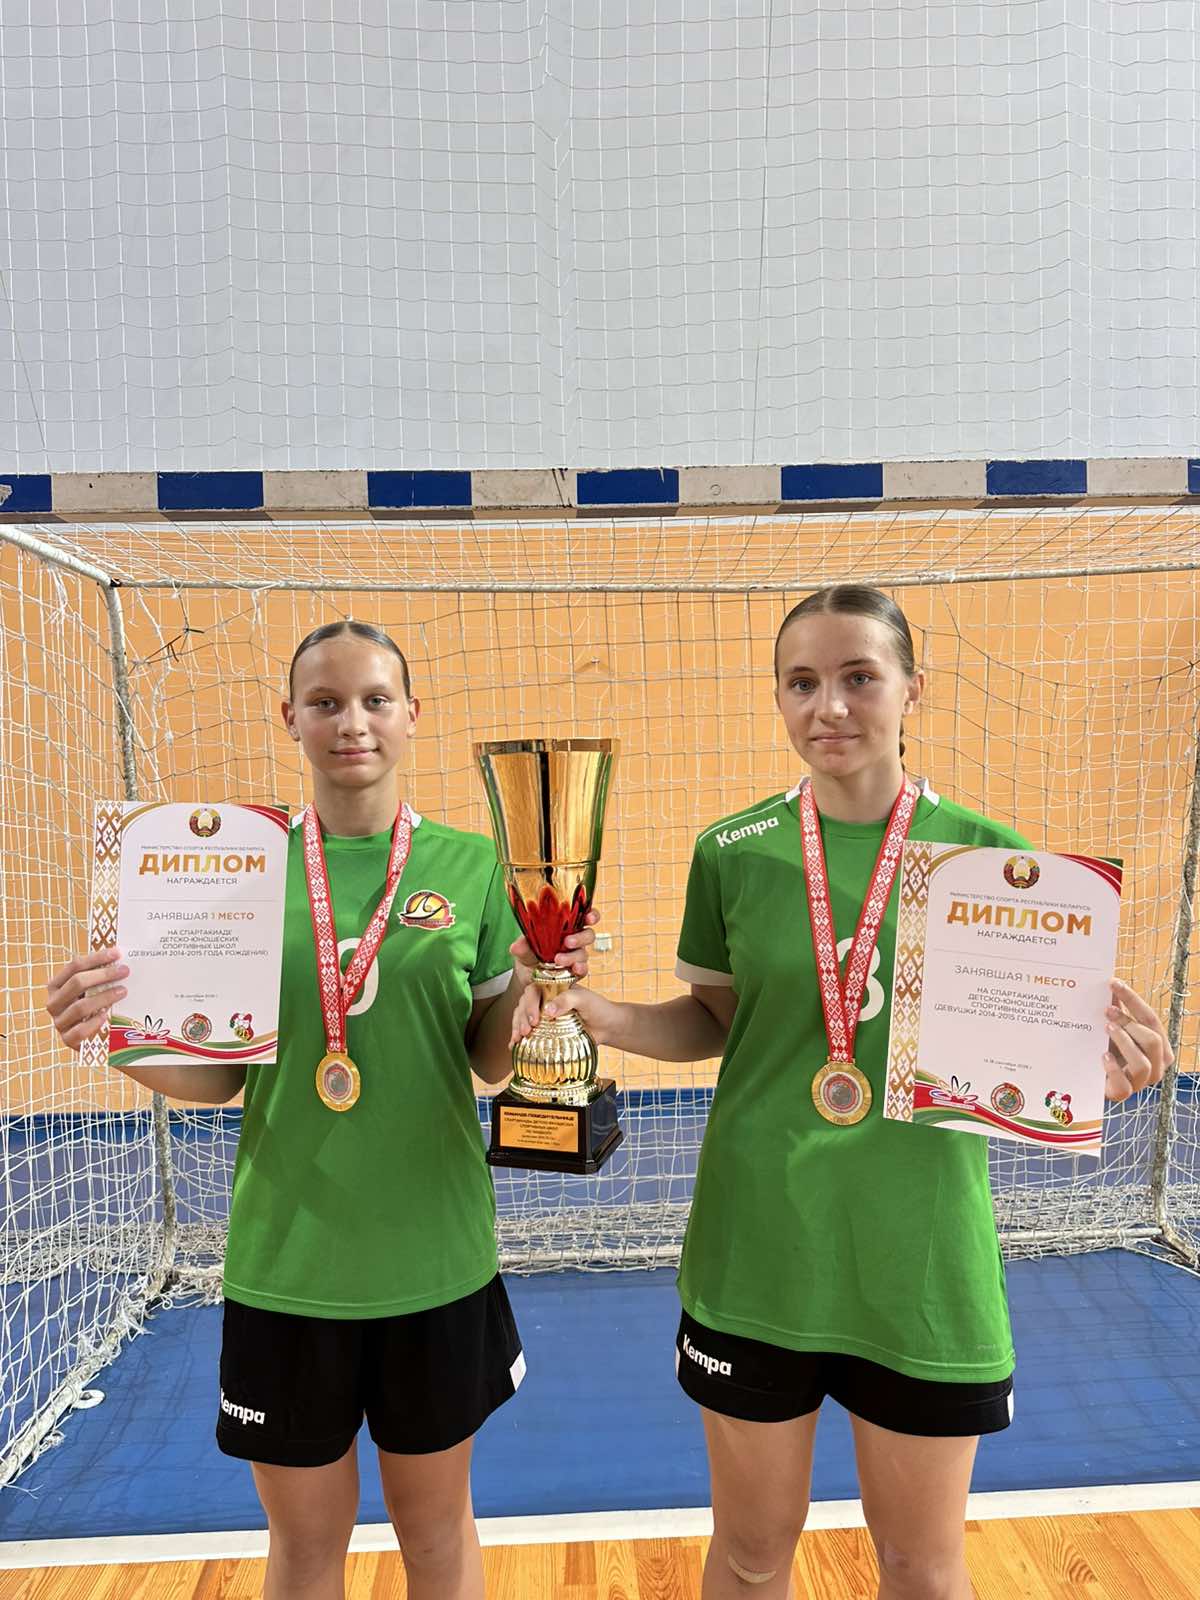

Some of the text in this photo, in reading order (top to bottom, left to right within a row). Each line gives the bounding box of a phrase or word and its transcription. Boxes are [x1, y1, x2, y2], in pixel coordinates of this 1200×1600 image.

[715, 816, 779, 848] Kempa
[138, 853, 267, 876] ДИПЛОМ
[166, 876, 238, 886] НАГРАЖДАЕТСЯ
[146, 911, 208, 921] ЗАНЯВШАЯ
[217, 911, 256, 921] МЕСТО
[946, 900, 1092, 936] ДИПЛОМ
[179, 929, 232, 937] СПАРТАКИАДЕ
[976, 928, 1057, 946] НАГРАЖДАЕТСЯ
[954, 964, 1077, 989] ЗАНЯВШАЯ 1 МЕСТО
[967, 993, 1057, 1011] ДЕТСКО-ЮНОШЕСКИХ
[977, 986, 1050, 1003] НА СПАРТАКИАДЕ
[934, 1003, 1093, 1032] (ДЕВУШКИ 2014-2015 ГОДА РОЖДЕНИЯ)
[970, 1001, 1054, 1018] СПОРТИВНЫХ ШКОЛ
[683, 1333, 732, 1376] Kempa
